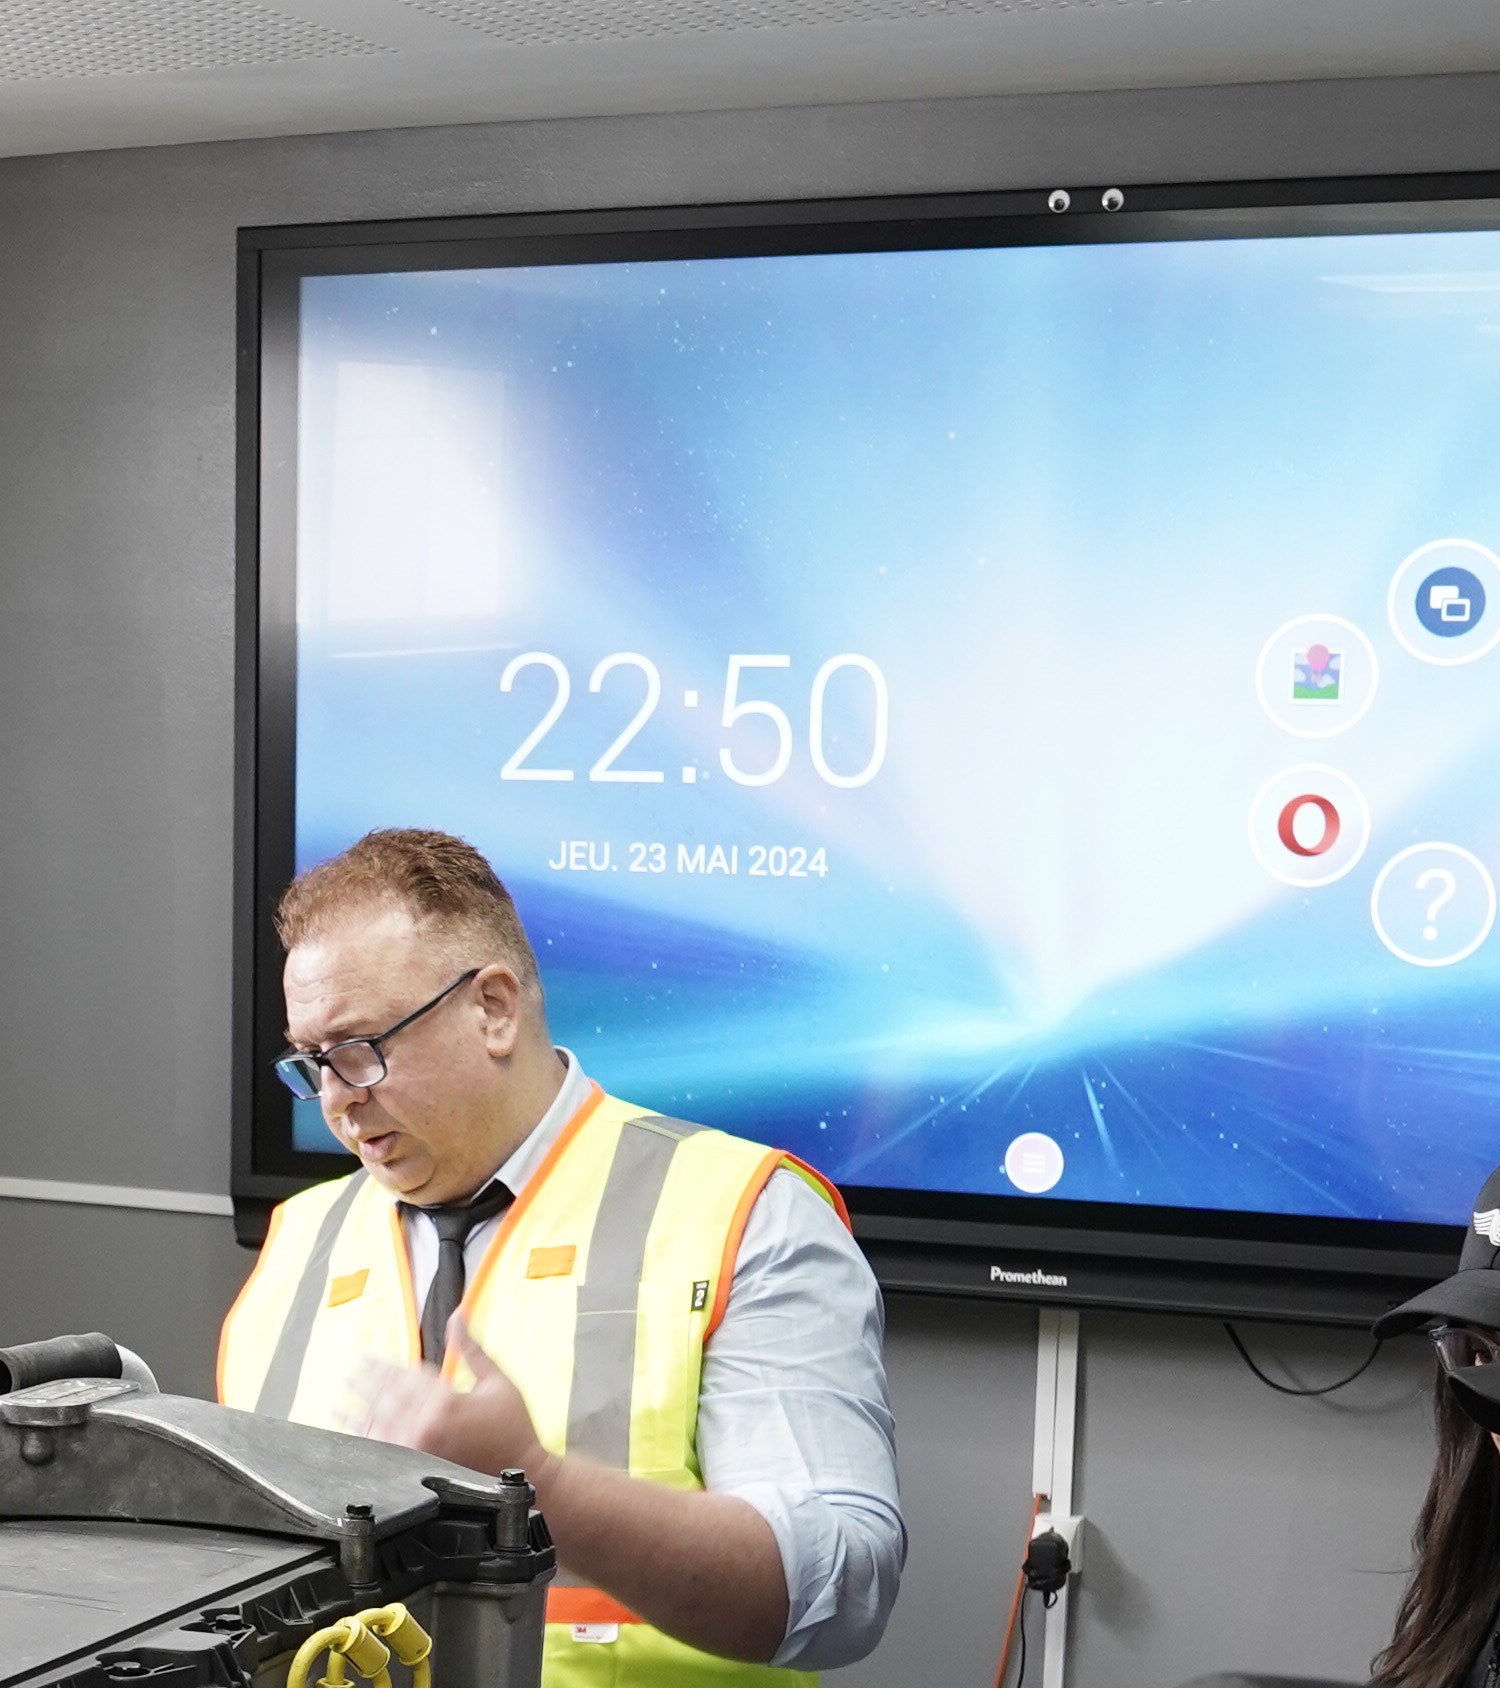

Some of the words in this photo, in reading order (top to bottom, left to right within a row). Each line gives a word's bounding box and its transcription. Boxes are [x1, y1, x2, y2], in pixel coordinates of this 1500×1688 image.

[500, 651, 889, 788] 22:50
[549, 841, 617, 872] JEU.
[628, 842, 667, 873] 23
[678, 844, 738, 875] MAI
[748, 846, 829, 878] 2024
[990, 1265, 1068, 1287] Promethean
[694, 1289, 705, 1307] 2
